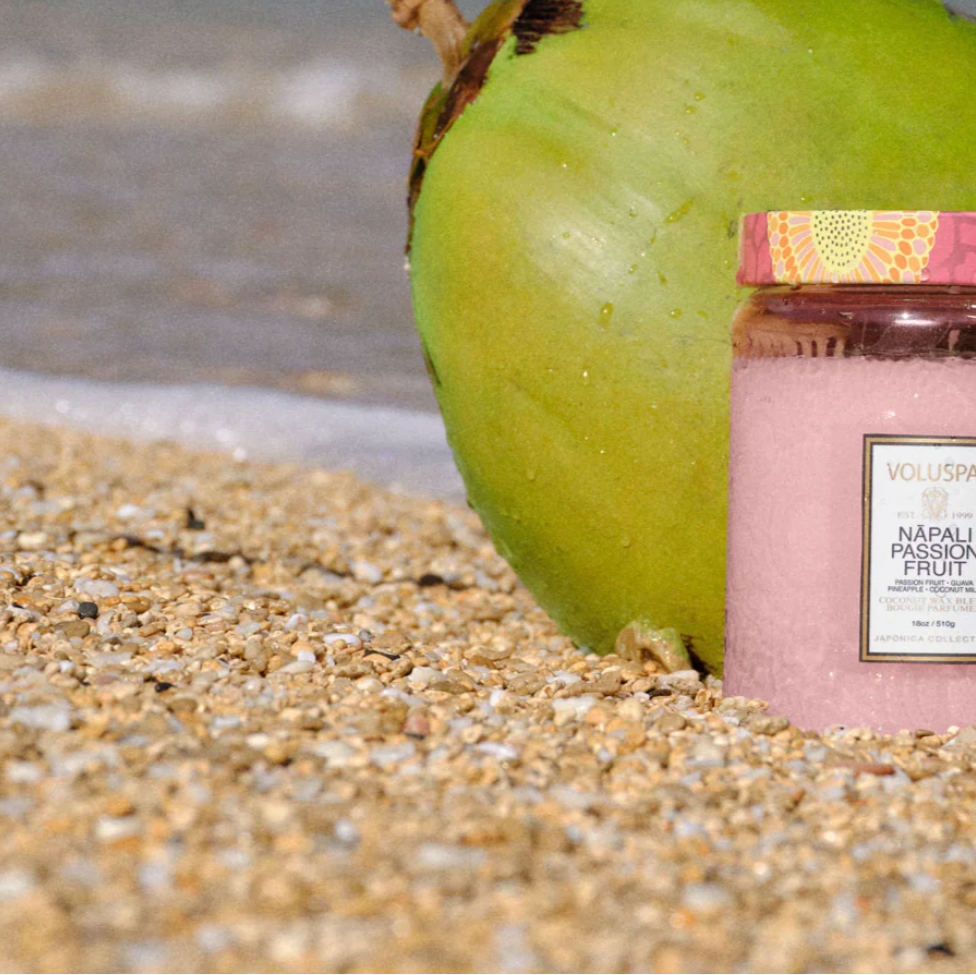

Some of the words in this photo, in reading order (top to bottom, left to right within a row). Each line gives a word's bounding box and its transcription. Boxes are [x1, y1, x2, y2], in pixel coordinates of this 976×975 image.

[898, 524, 972, 543] NĀPALI
[904, 560, 968, 576] FRUIT
[878, 596, 926, 604] COCONUT
[886, 604, 925, 612] BOUGIE
[935, 620, 955, 629] 510g
[873, 634, 924, 642] JAPONICA
